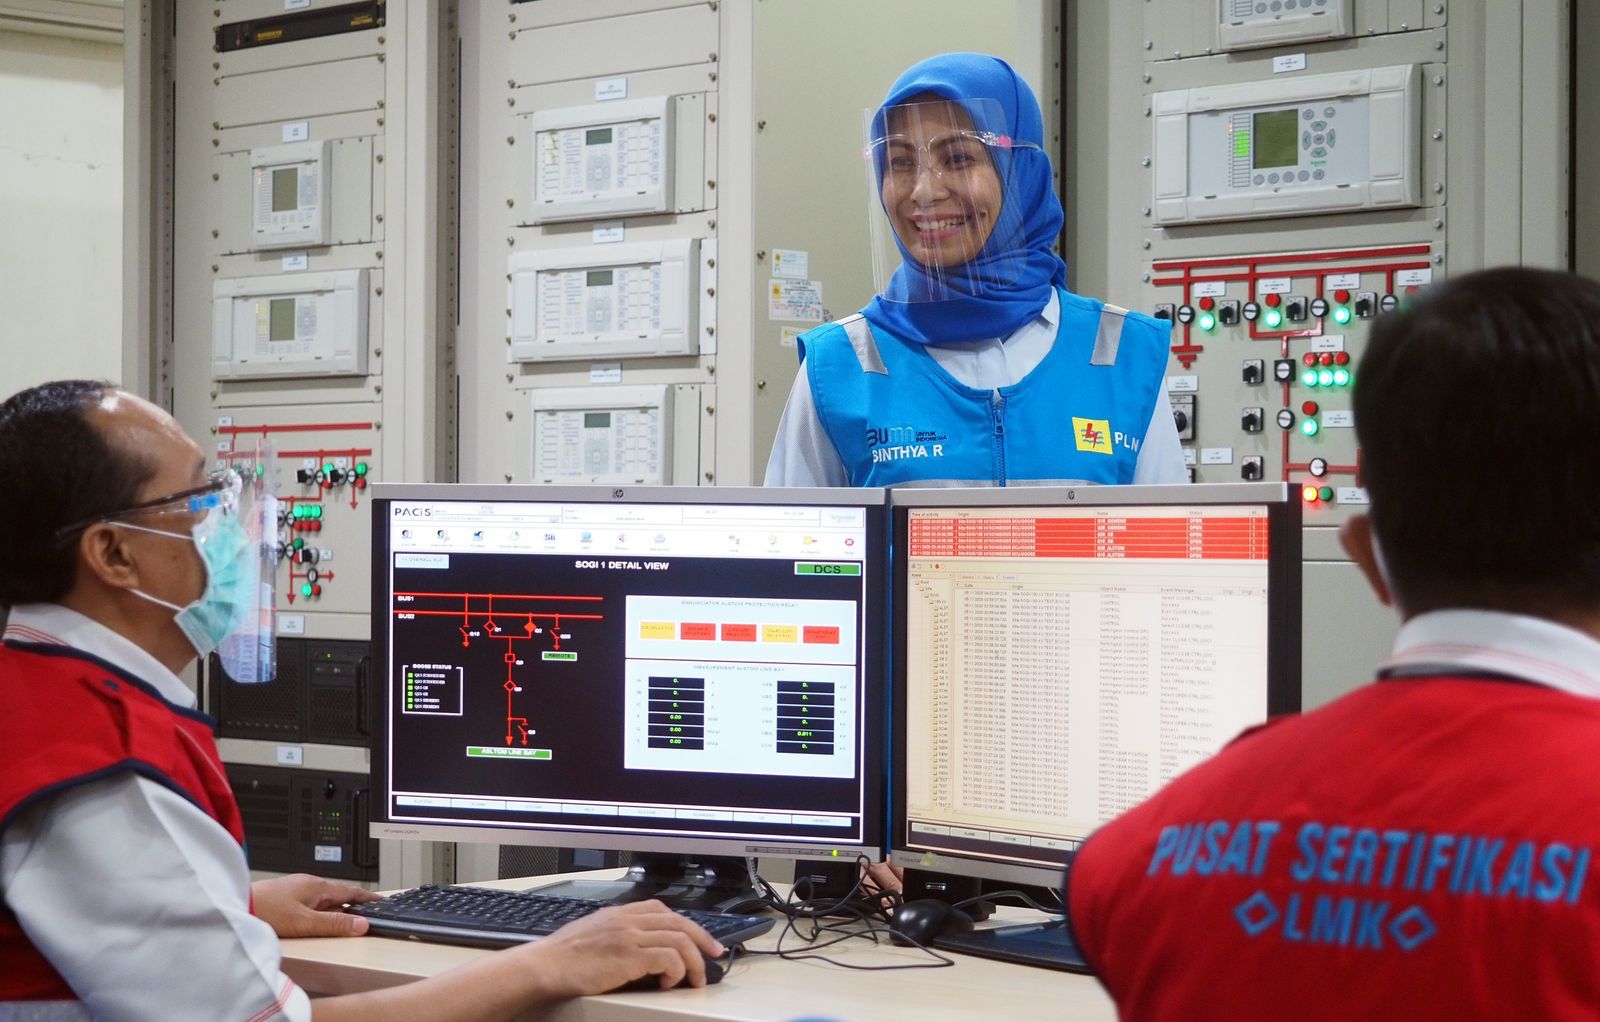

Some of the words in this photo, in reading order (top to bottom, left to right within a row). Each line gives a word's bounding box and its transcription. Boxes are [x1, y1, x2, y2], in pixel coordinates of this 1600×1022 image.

[1114, 431, 1139, 452] PLN
[872, 445, 928, 463] SINTHYA
[933, 444, 944, 457] R
[814, 564, 842, 574] DCS
[1146, 820, 1281, 878] PUSAT
[1290, 821, 1590, 904] SERTIFIKASI
[1283, 892, 1391, 950] LMK
